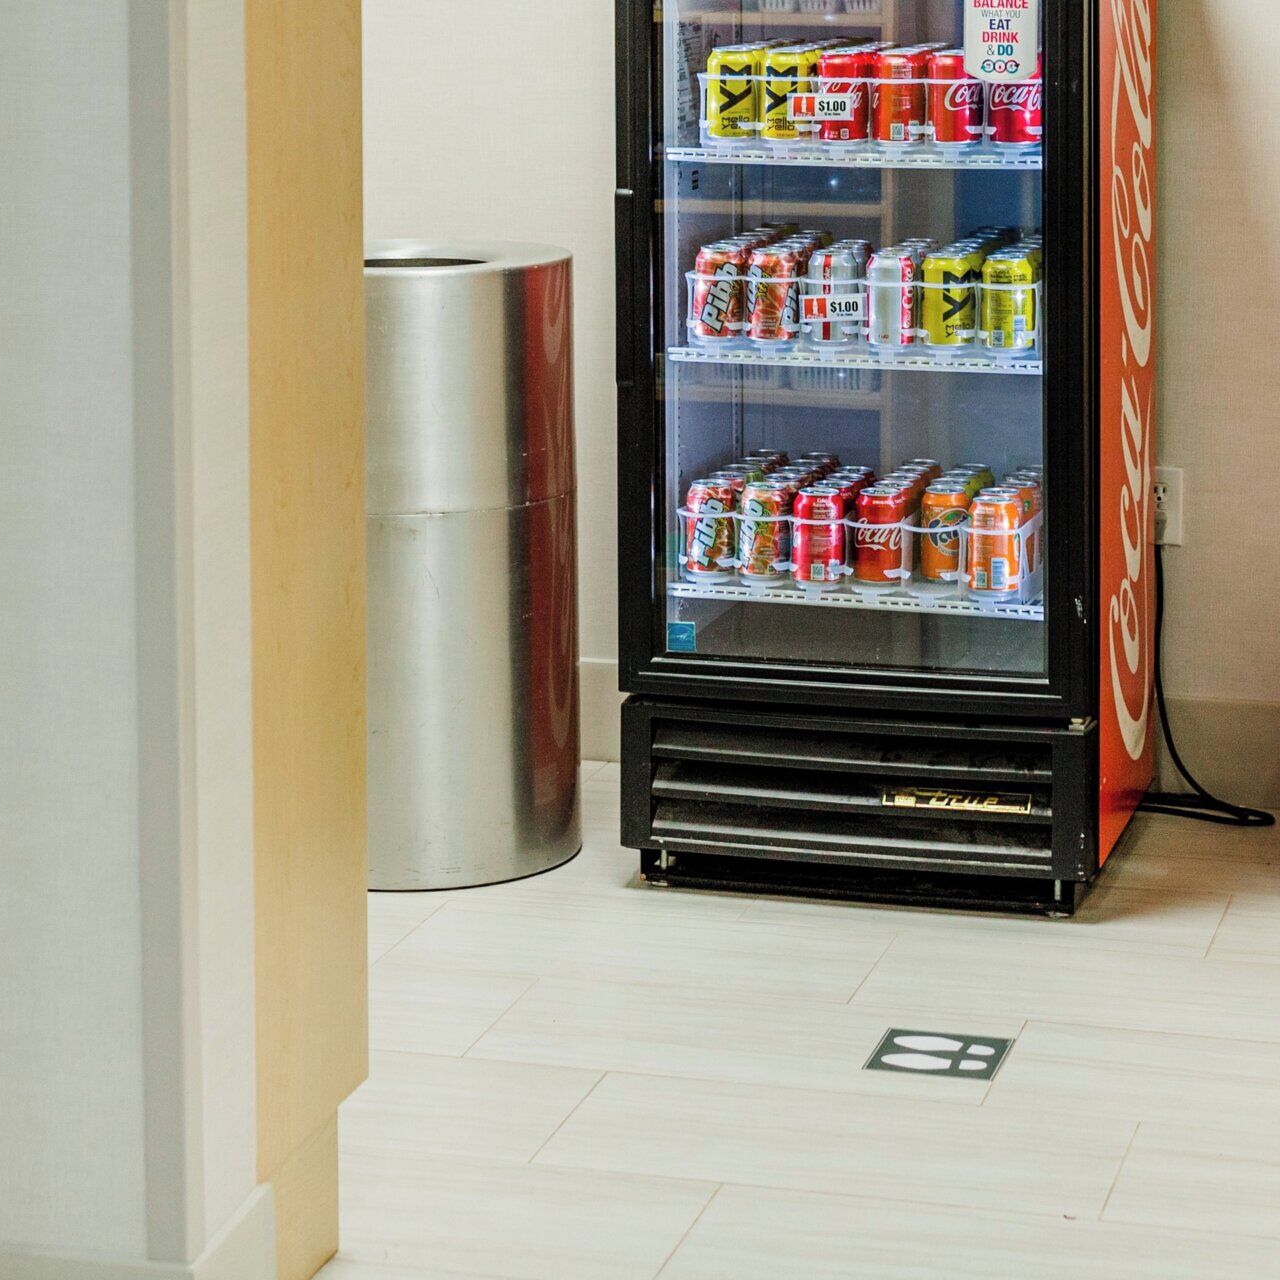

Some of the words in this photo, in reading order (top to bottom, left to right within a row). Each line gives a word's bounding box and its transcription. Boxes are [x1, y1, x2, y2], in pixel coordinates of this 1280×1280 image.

[981, 9, 1004, 18] WHAT
[1005, 9, 1021, 19] YOU
[989, 18, 1012, 30] EAT
[982, 31, 1019, 43] DRINK
[986, 44, 995, 56] &
[997, 44, 1014, 56] DO
[818, 100, 847, 113] $1.00
[829, 300, 859, 313] $1.00
